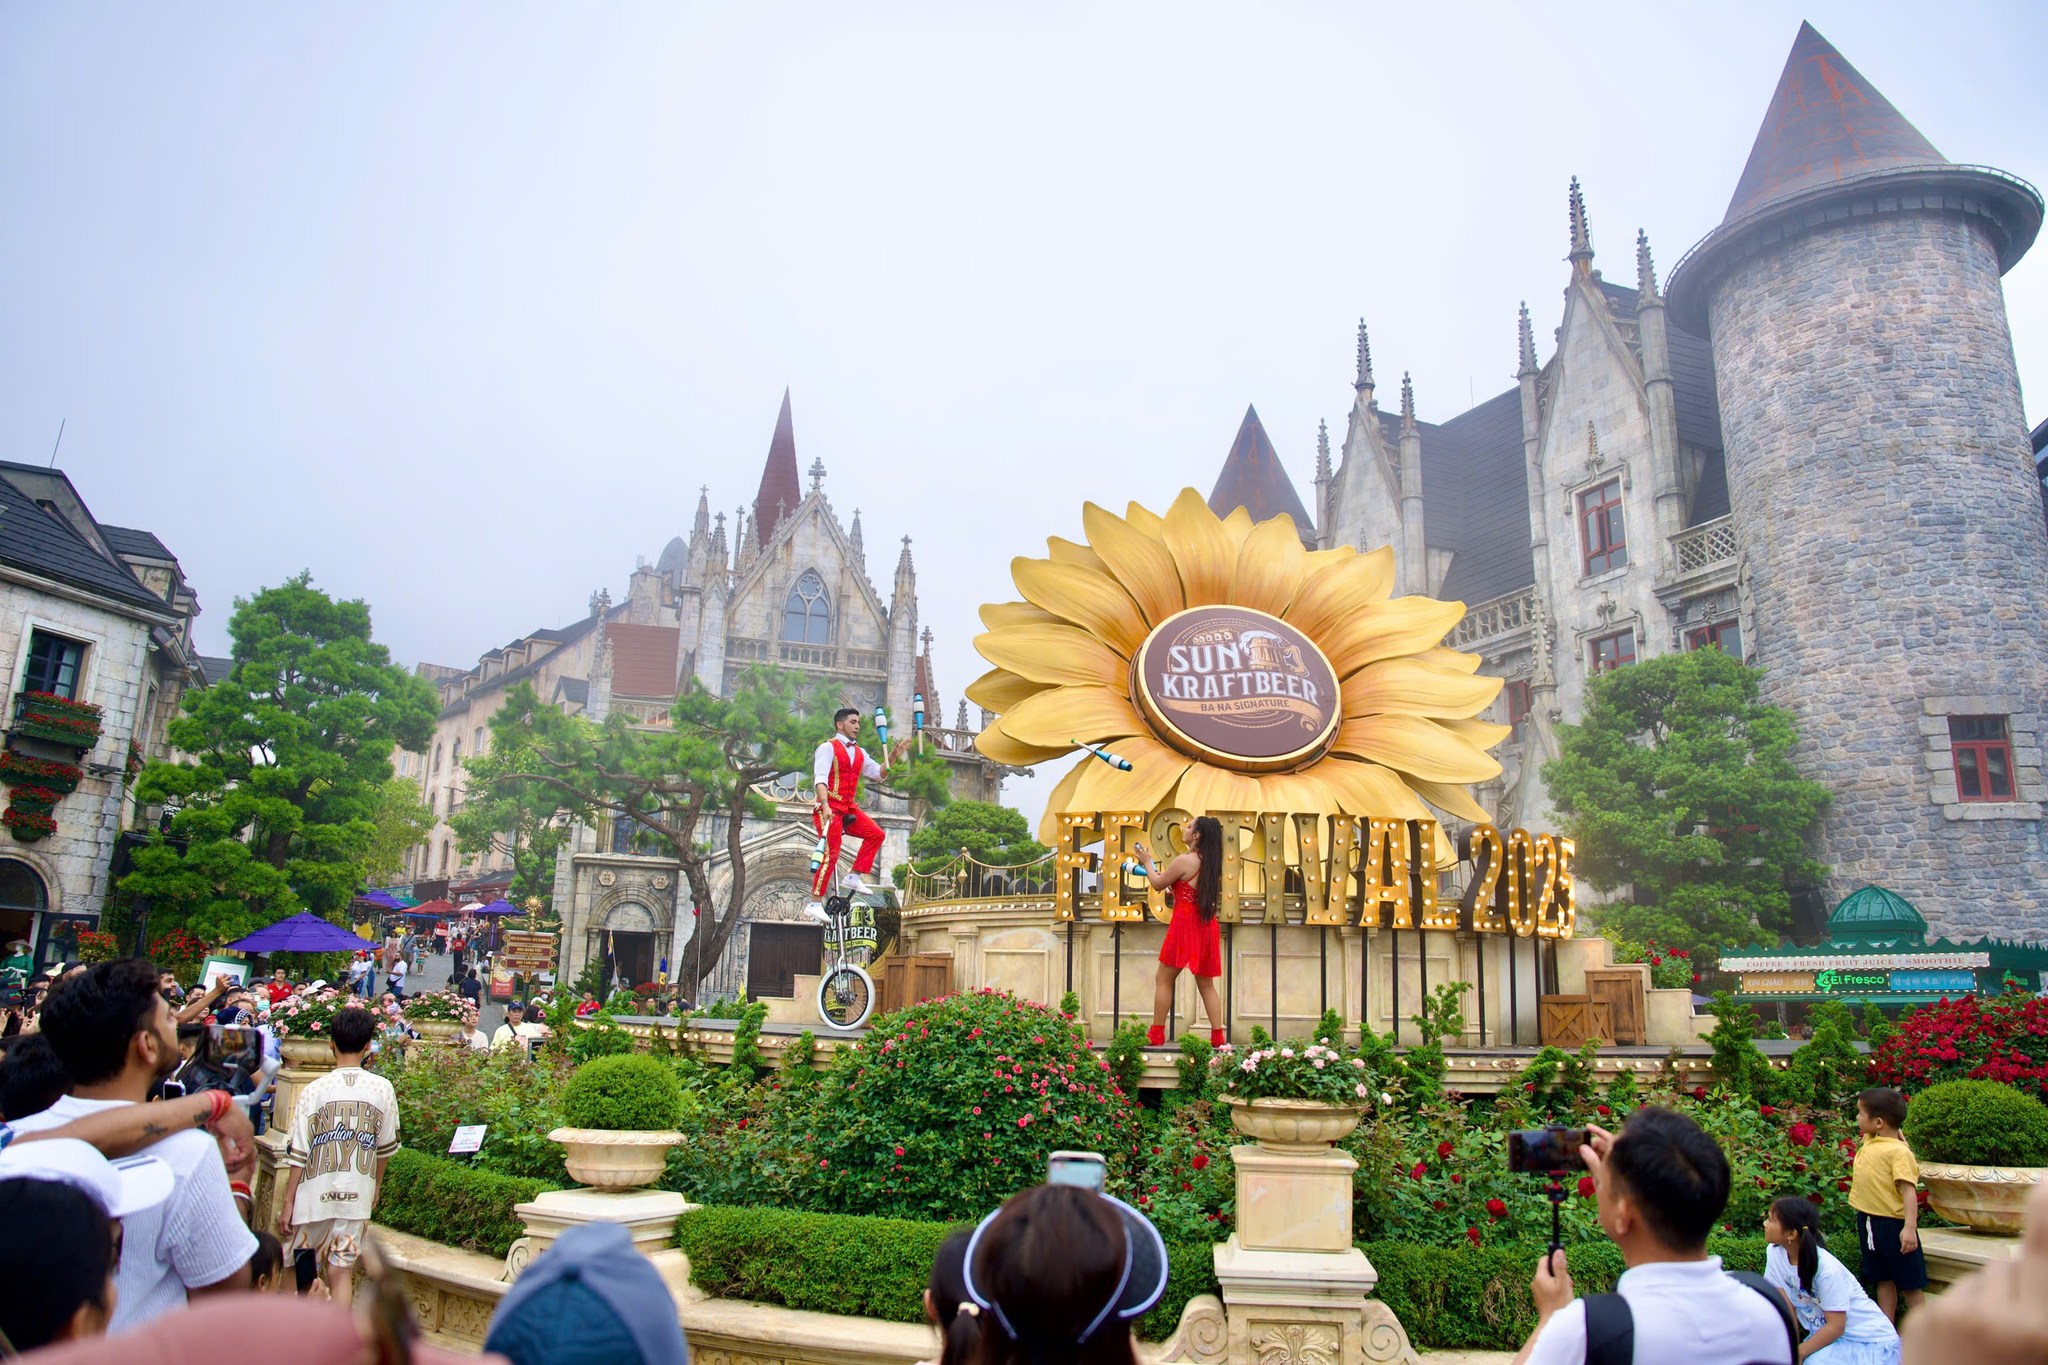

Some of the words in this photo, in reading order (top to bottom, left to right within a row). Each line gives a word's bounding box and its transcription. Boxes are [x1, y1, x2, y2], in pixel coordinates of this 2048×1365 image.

[1168, 642, 1243, 673] SUN
[1161, 671, 1320, 706] KRAFTBEER
[1201, 703, 1215, 712] BA
[1217, 702, 1233, 711] NA
[1234, 699, 1291, 711] SIGNATURE
[1055, 808, 1457, 927] FESTIVAL
[1459, 822, 1576, 941] 2025
[1829, 959, 1860, 967] FRUIT
[1905, 957, 1965, 965] SMOOTHIE
[1746, 979, 1760, 987] XIN
[1831, 975, 1842, 985] El
[1844, 974, 1885, 985] Fresco
[311, 1122, 355, 1150] uardian
[356, 1130, 377, 1150] ang
